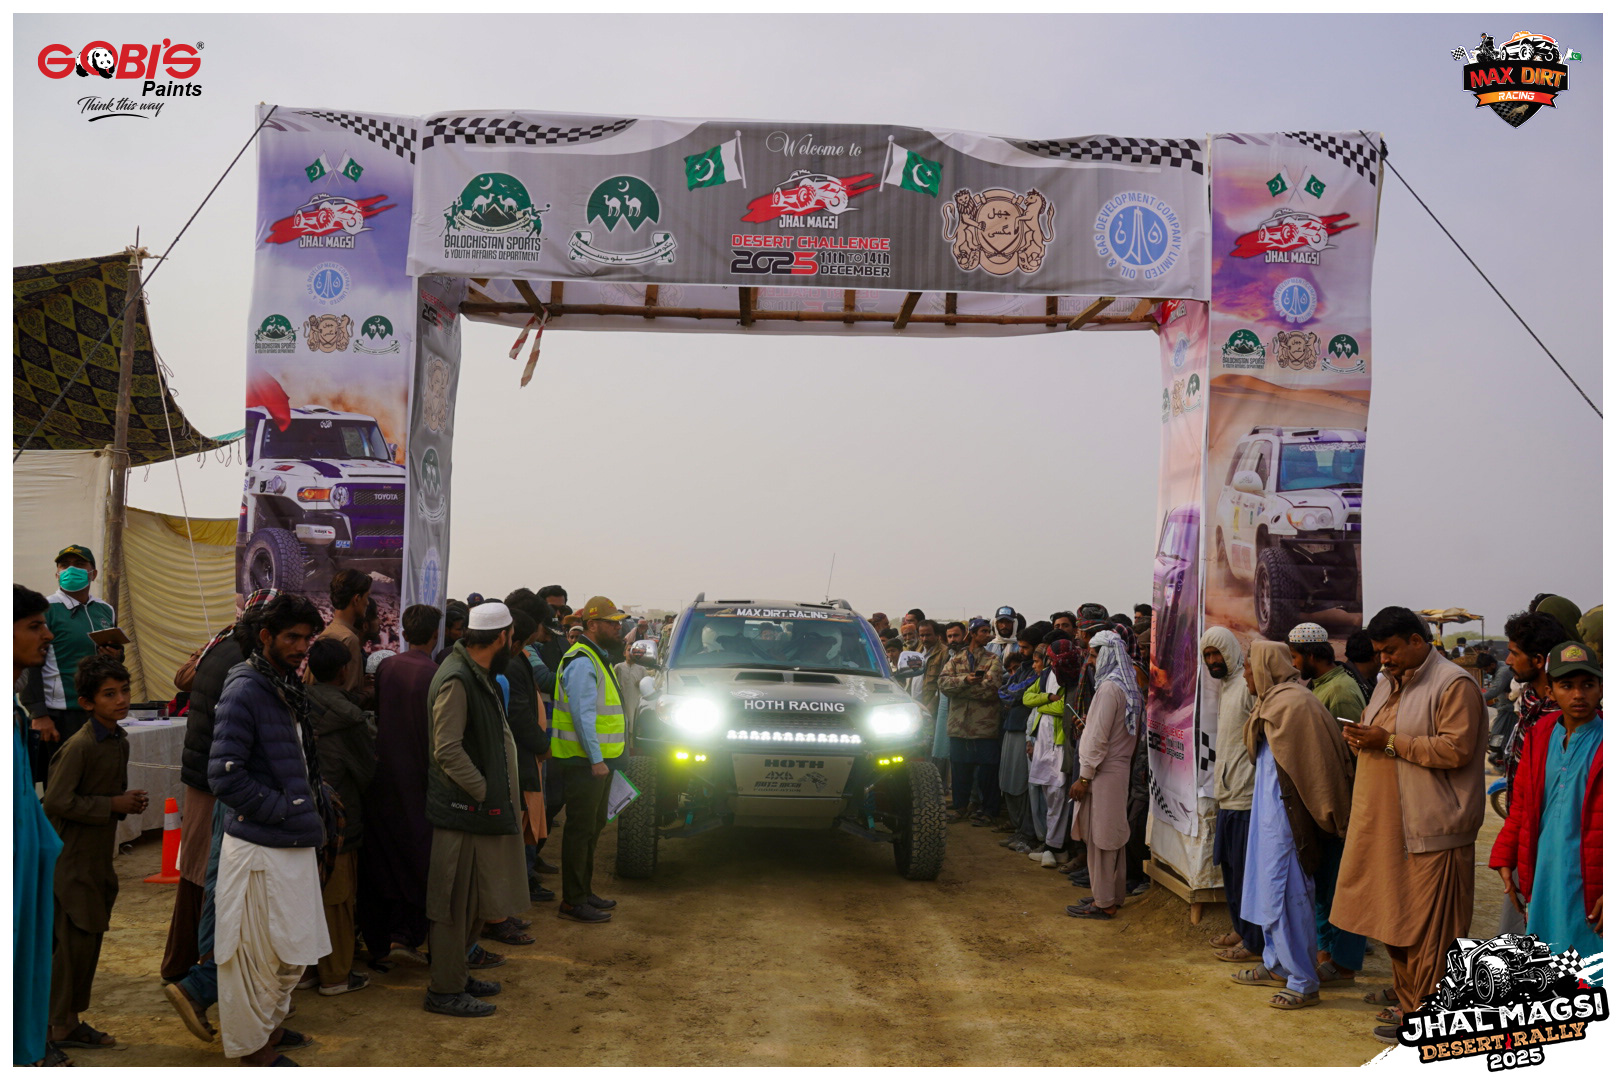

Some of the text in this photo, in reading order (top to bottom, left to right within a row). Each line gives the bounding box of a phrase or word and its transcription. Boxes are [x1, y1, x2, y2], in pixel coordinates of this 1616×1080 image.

[766, 131, 862, 157] Welcome to
[1096, 192, 1156, 230] DEVELOPMENT
[779, 214, 839, 229] JHAL MAGSI
[1156, 202, 1182, 250] COMPANY
[299, 235, 355, 249] JHAL MAGSI
[444, 234, 541, 251] BALOCHISTAN SPORTS
[732, 234, 891, 250] DESERT CHALLENGE
[1095, 234, 1109, 256] GAS
[451, 249, 471, 259] YOUTH
[472, 249, 497, 260] AFFAIRS
[499, 251, 540, 261] DEPARTMENT
[820, 251, 890, 265] 11th TO 14th
[1265, 250, 1320, 266] JHAL MAGSI
[730, 250, 819, 276] 2025
[1145, 251, 1178, 279] LIMITED
[820, 265, 891, 277] DECEMBER
[1121, 265, 1136, 279] OIL
[737, 608, 761, 616] MAX
[763, 609, 787, 617] DIRT
[789, 610, 828, 619] RACING
[744, 700, 845, 713] HOTH RACING
[764, 759, 825, 769] HOTH
